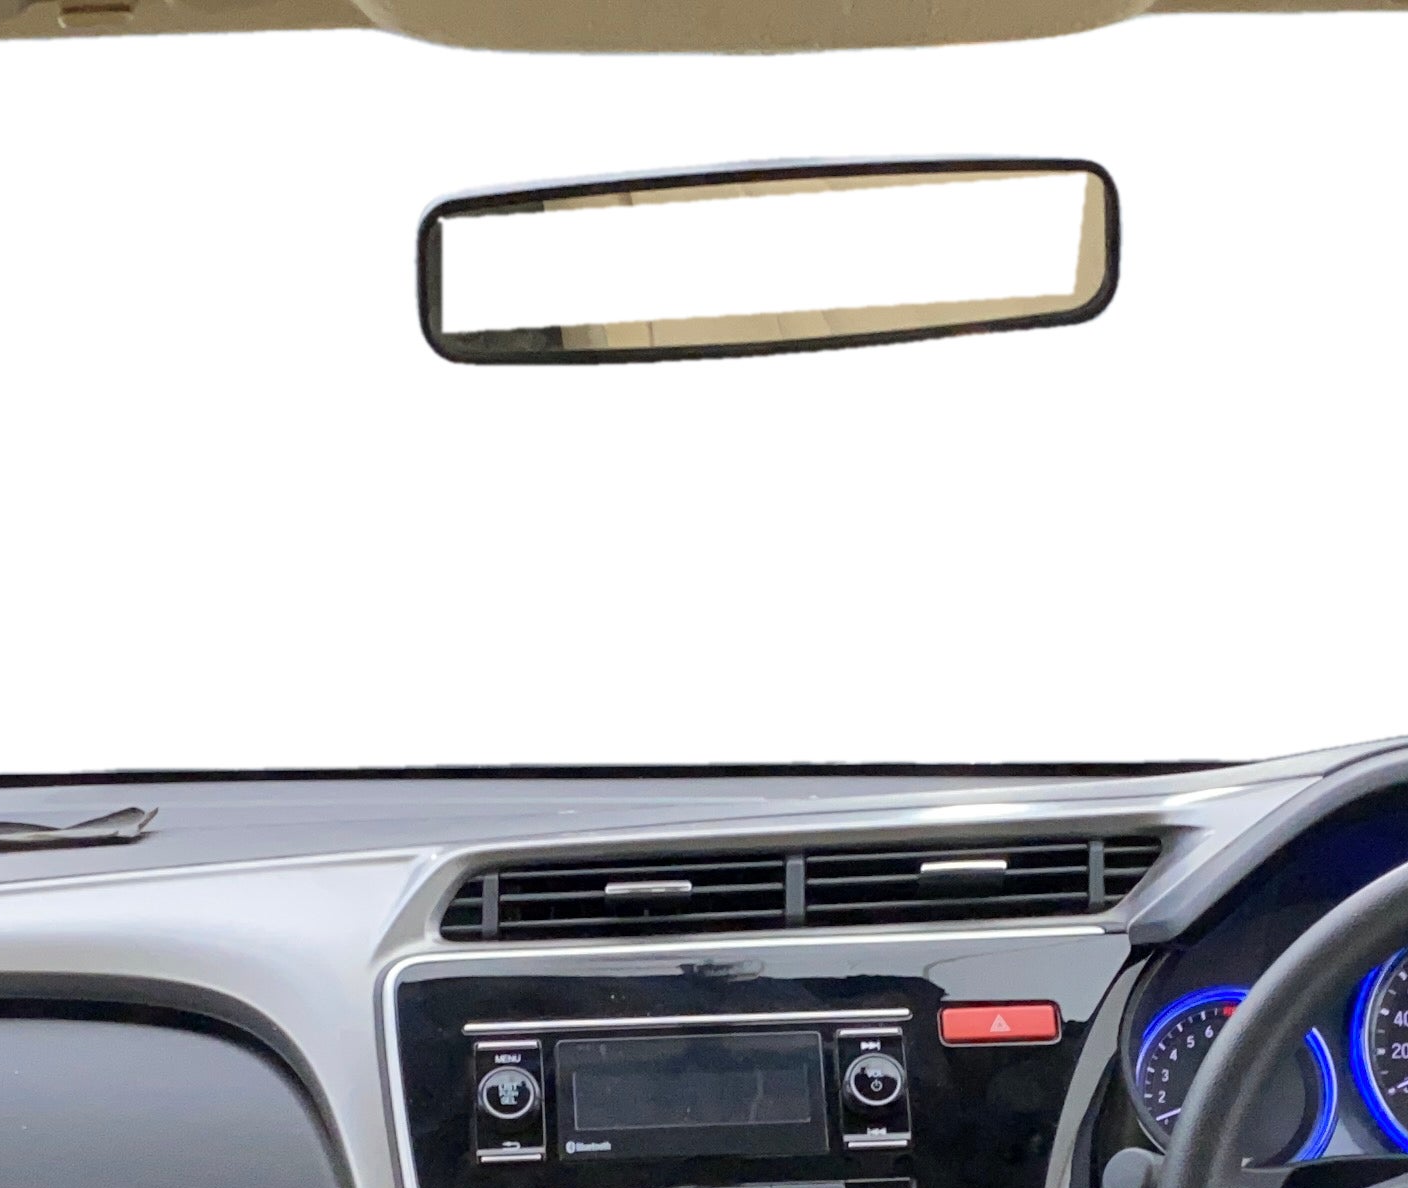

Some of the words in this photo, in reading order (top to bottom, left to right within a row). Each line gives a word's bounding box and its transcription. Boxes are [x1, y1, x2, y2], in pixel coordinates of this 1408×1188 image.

[1204, 1025, 1214, 1038] 6
[1186, 1035, 1195, 1048] 5
[494, 1054, 521, 1064] MENU
[1169, 1049, 1178, 1061] 4
[1161, 1069, 1170, 1082] 3
[1158, 1091, 1166, 1103] 2
